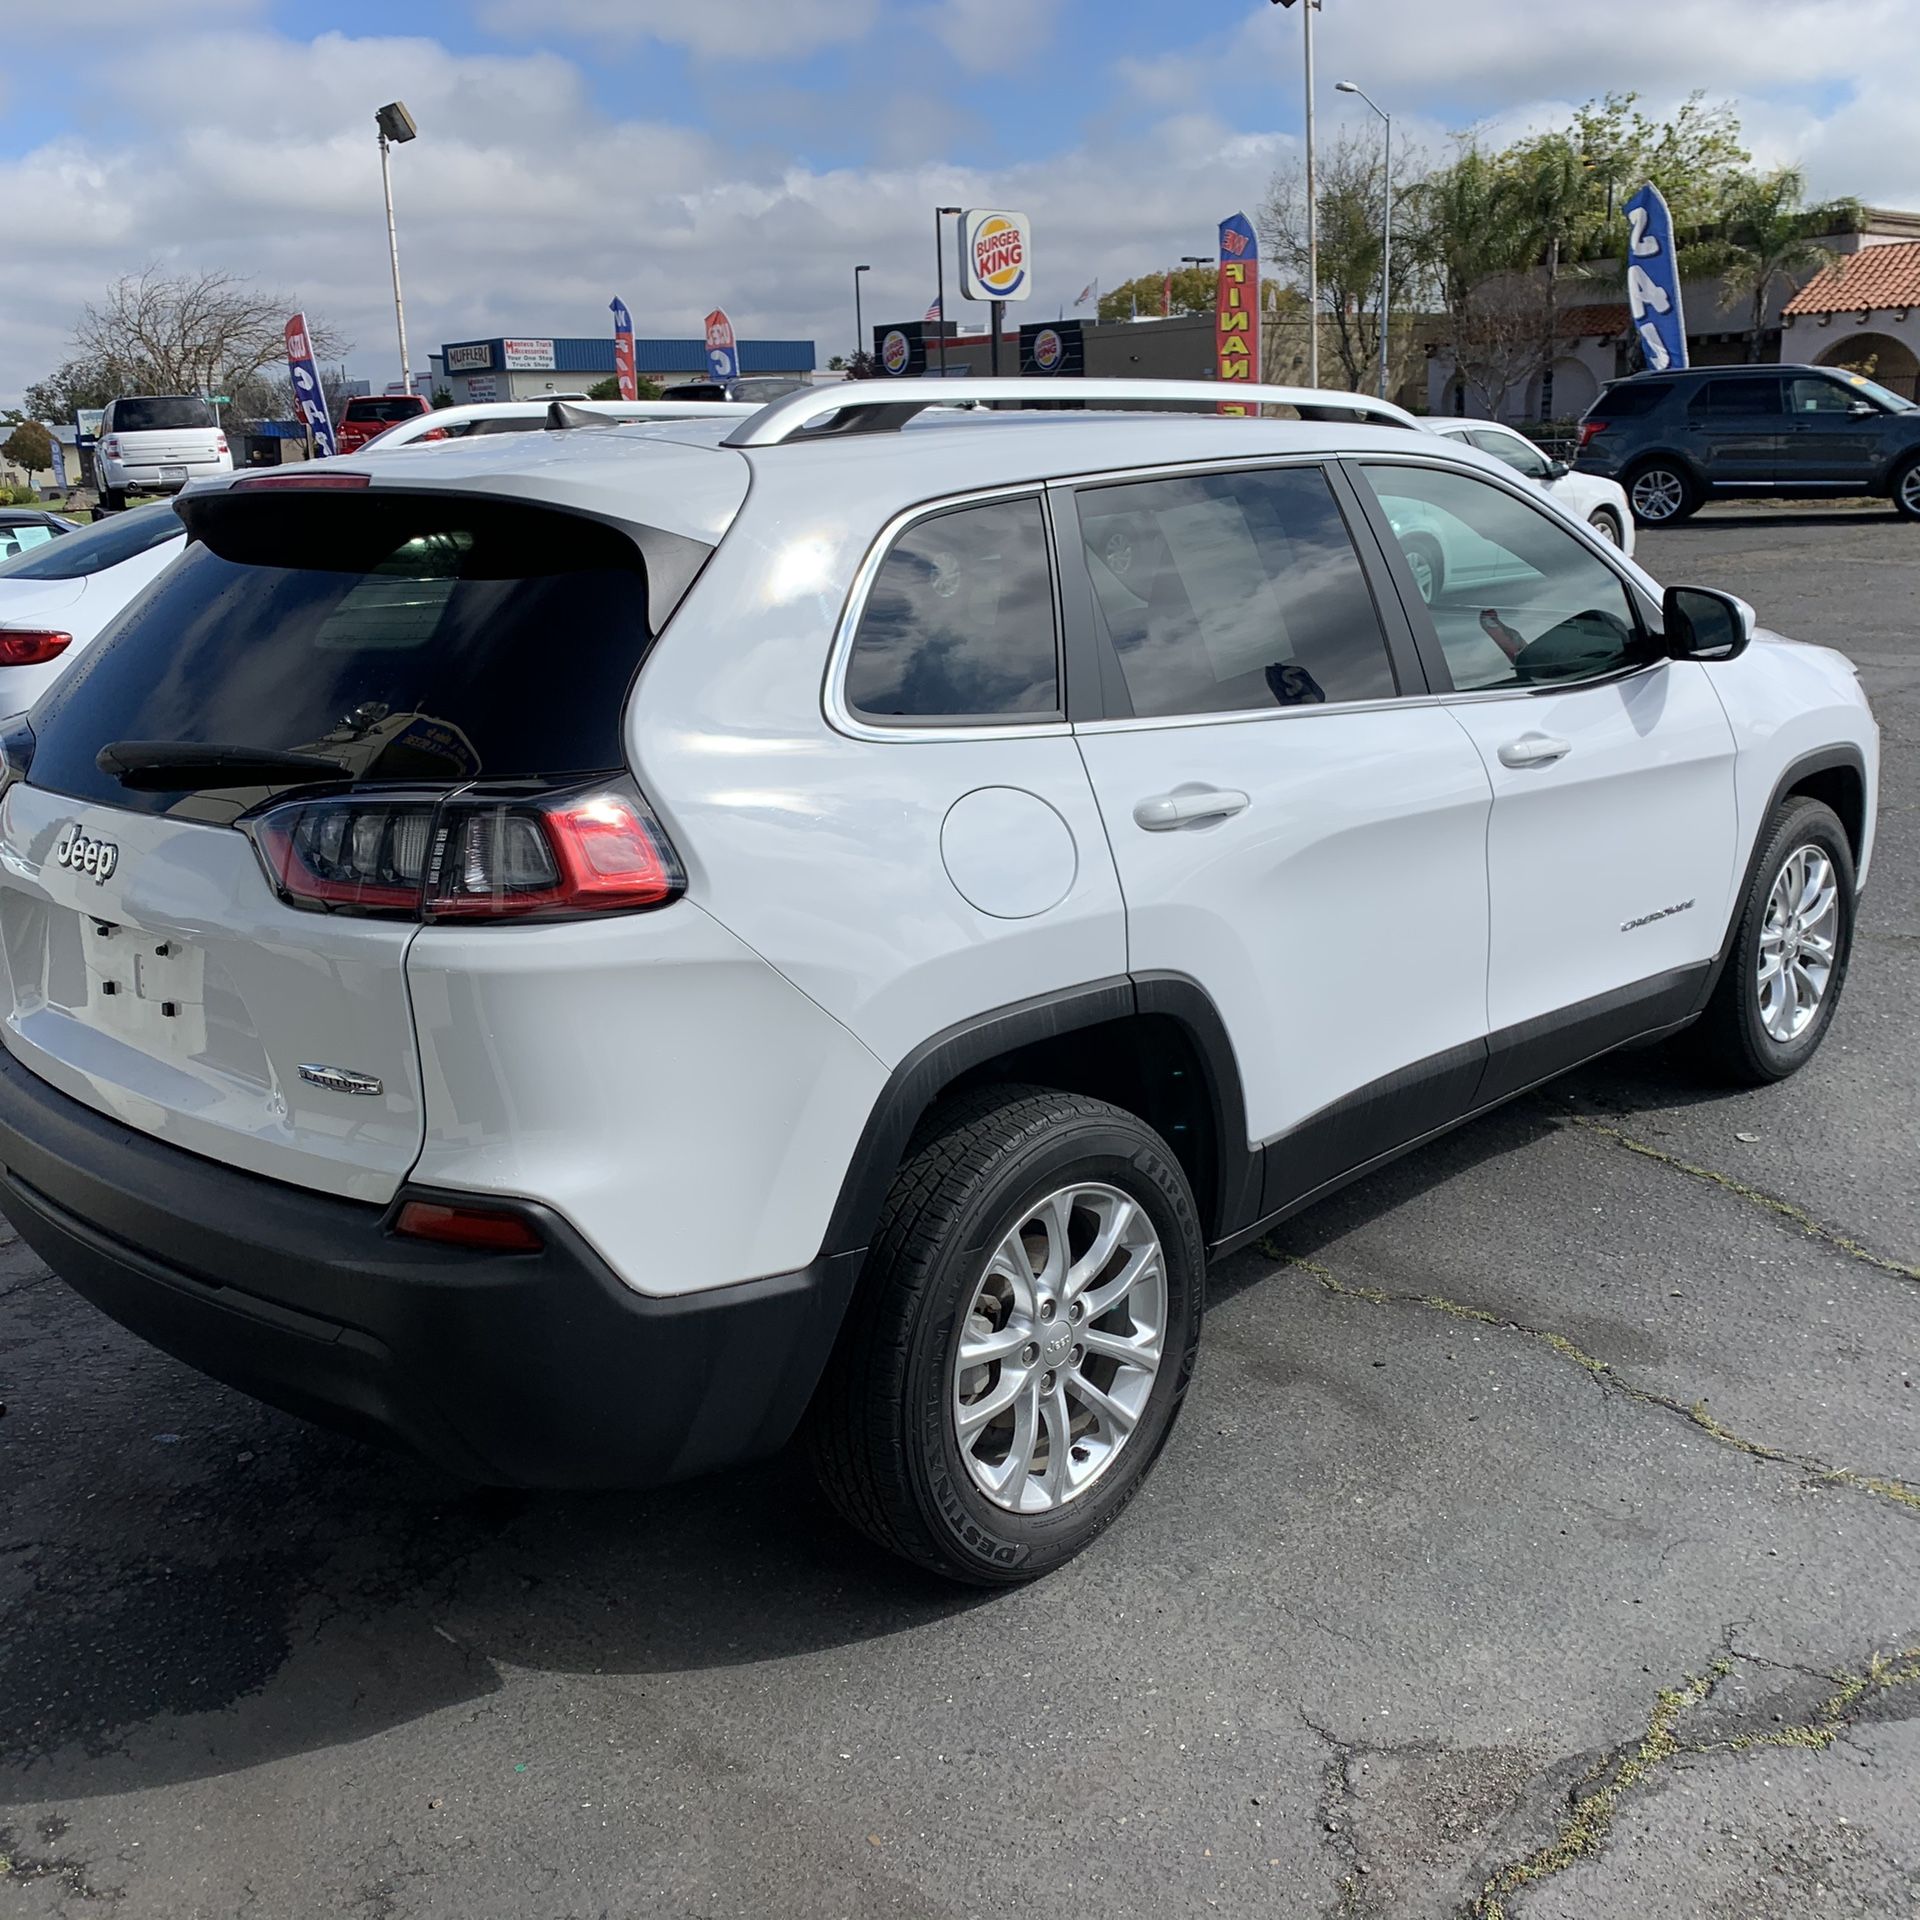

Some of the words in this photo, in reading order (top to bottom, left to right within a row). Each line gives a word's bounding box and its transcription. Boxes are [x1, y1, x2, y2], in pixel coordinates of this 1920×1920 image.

[976, 229, 1021, 258] BURGER
[978, 243, 1023, 279] KING
[449, 347, 488, 364] MUFFLERS
[57, 824, 119, 886] Jeep
